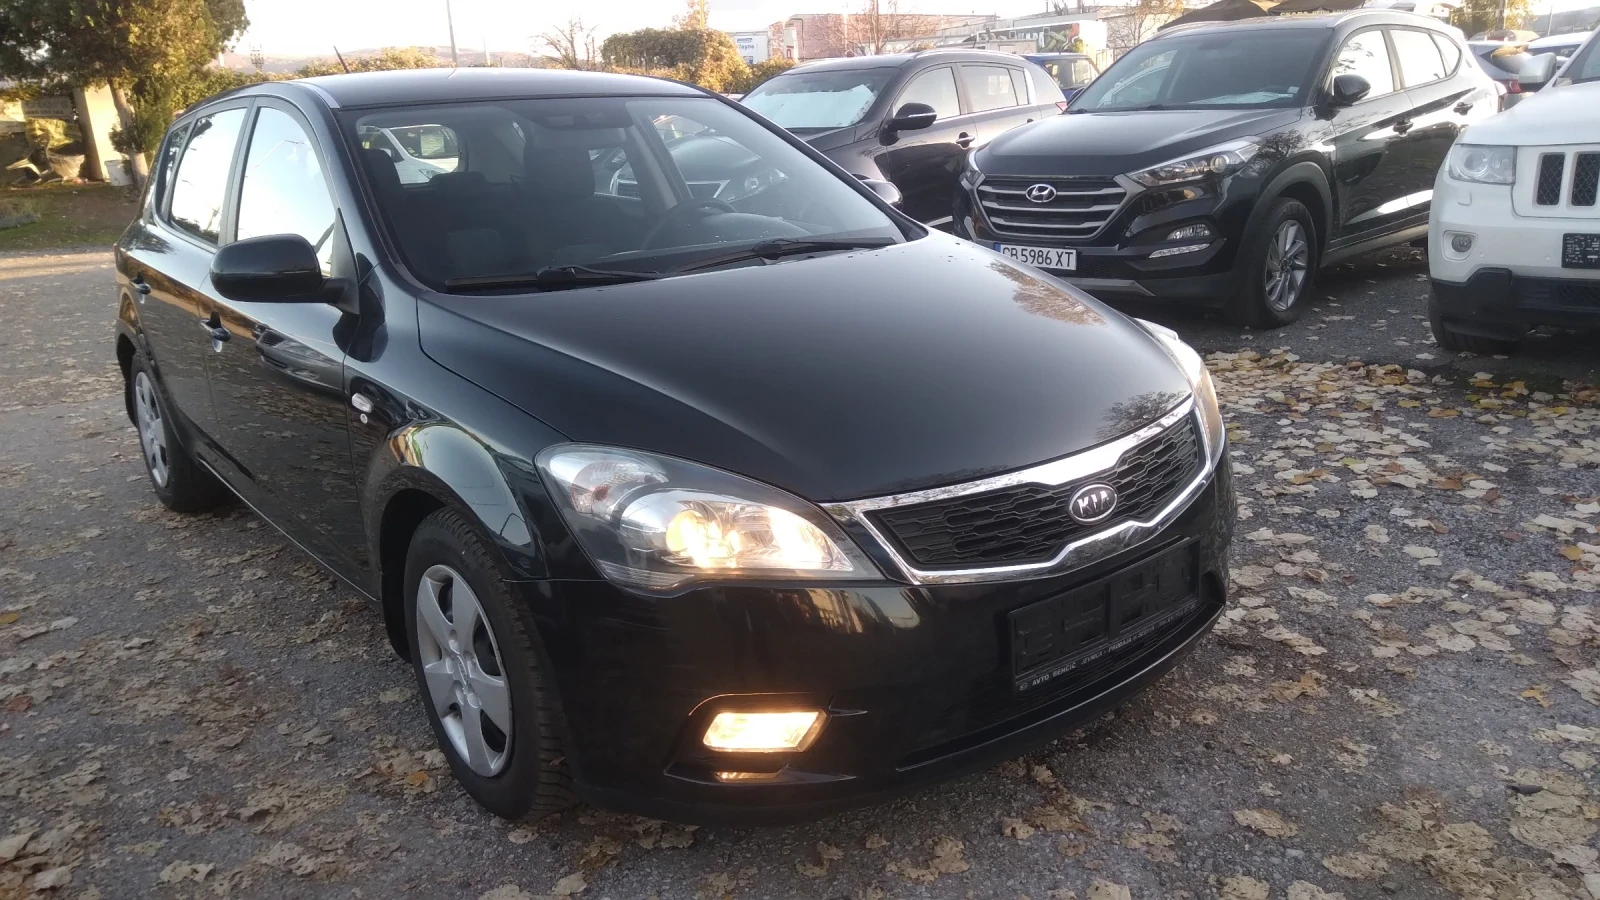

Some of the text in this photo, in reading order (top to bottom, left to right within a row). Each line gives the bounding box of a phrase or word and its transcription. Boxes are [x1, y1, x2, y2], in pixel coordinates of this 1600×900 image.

[1020, 248, 1052, 265] 5986
[1055, 250, 1074, 267] XT
[1076, 490, 1110, 517] KIA
[1032, 673, 1050, 686] AVTO
